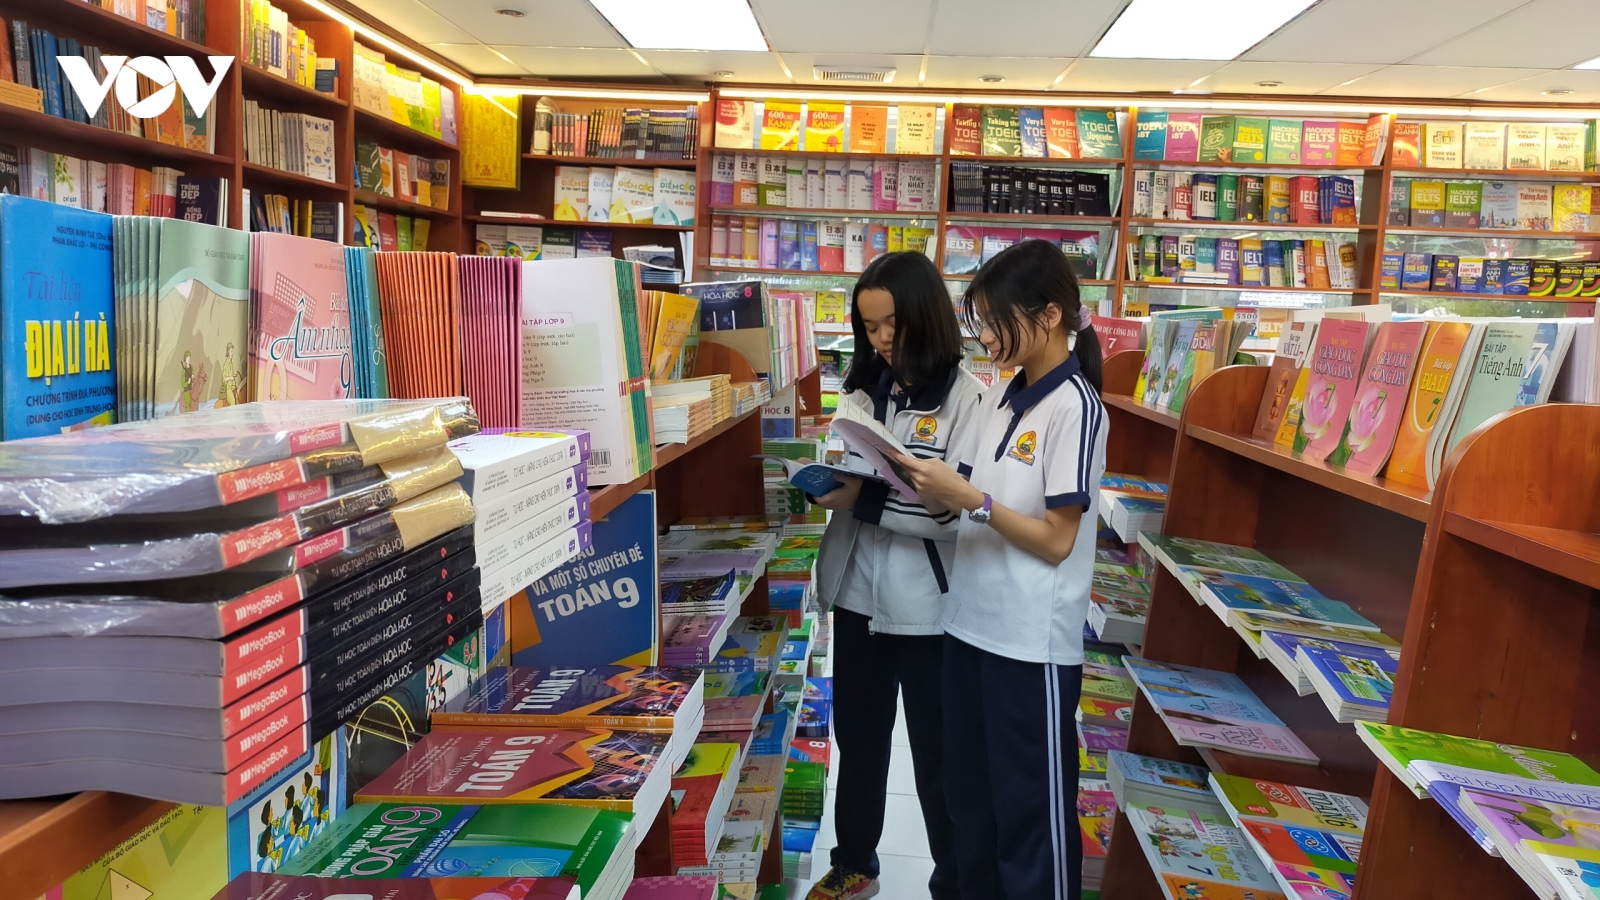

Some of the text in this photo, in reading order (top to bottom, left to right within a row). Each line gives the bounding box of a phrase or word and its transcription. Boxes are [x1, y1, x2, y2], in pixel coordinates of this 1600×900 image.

[812, 112, 828, 120] 600
[1081, 120, 1116, 134] TOEIC
[1271, 125, 1299, 134] HACKERS
[1270, 132, 1299, 143] IELTS
[1305, 133, 1336, 143] IELTS
[660, 179, 679, 191] ĐIỂM
[1078, 183, 1097, 193] IELTS
[1334, 181, 1354, 195] IELTS
[1414, 187, 1441, 195] HACKERS
[1450, 189, 1478, 197] HACKERS
[1414, 193, 1440, 203] IELTS
[1449, 195, 1478, 205] IELTS
[946, 239, 975, 250] IELTS
[1061, 244, 1091, 254] IELTS
[544, 318, 559, 326] LỚP
[24, 319, 65, 386] ĐỊA
[84, 312, 111, 372] HÀ
[1108, 338, 1117, 349] 7
[1479, 354, 1524, 381] Tiếng Anh
[1523, 342, 1549, 379] 7
[1324, 383, 1336, 409] 7
[783, 405, 791, 414] 8
[1372, 391, 1388, 419] 7
[310, 536, 338, 553] MegaBook
[548, 570, 572, 591] MỘT
[573, 561, 587, 583] SỐ
[588, 552, 628, 577] CHUYÊN
[628, 541, 644, 563] ĐỀ
[245, 590, 284, 615] MegaBook
[538, 577, 640, 623] TOÁN 9
[248, 626, 286, 652] MegaBook
[245, 654, 284, 682] MegaBook
[249, 686, 288, 714] MegaBook
[512, 679, 577, 712] TOÁN
[249, 715, 289, 745] MegaBook
[603, 717, 618, 726] TOÁN
[249, 745, 289, 777] MegaBook
[455, 748, 536, 793] TOÁN
[504, 735, 546, 746] 9
[1438, 771, 1544, 798] Bài tập MĨ
[381, 806, 442, 825] 9
[102, 855, 115, 867] CỦA
[115, 847, 125, 858] BỘ
[125, 839, 139, 852] GIÁO
[140, 830, 152, 843] DỤC
[152, 824, 160, 834] VÀ
[159, 817, 171, 829] ĐÀO
